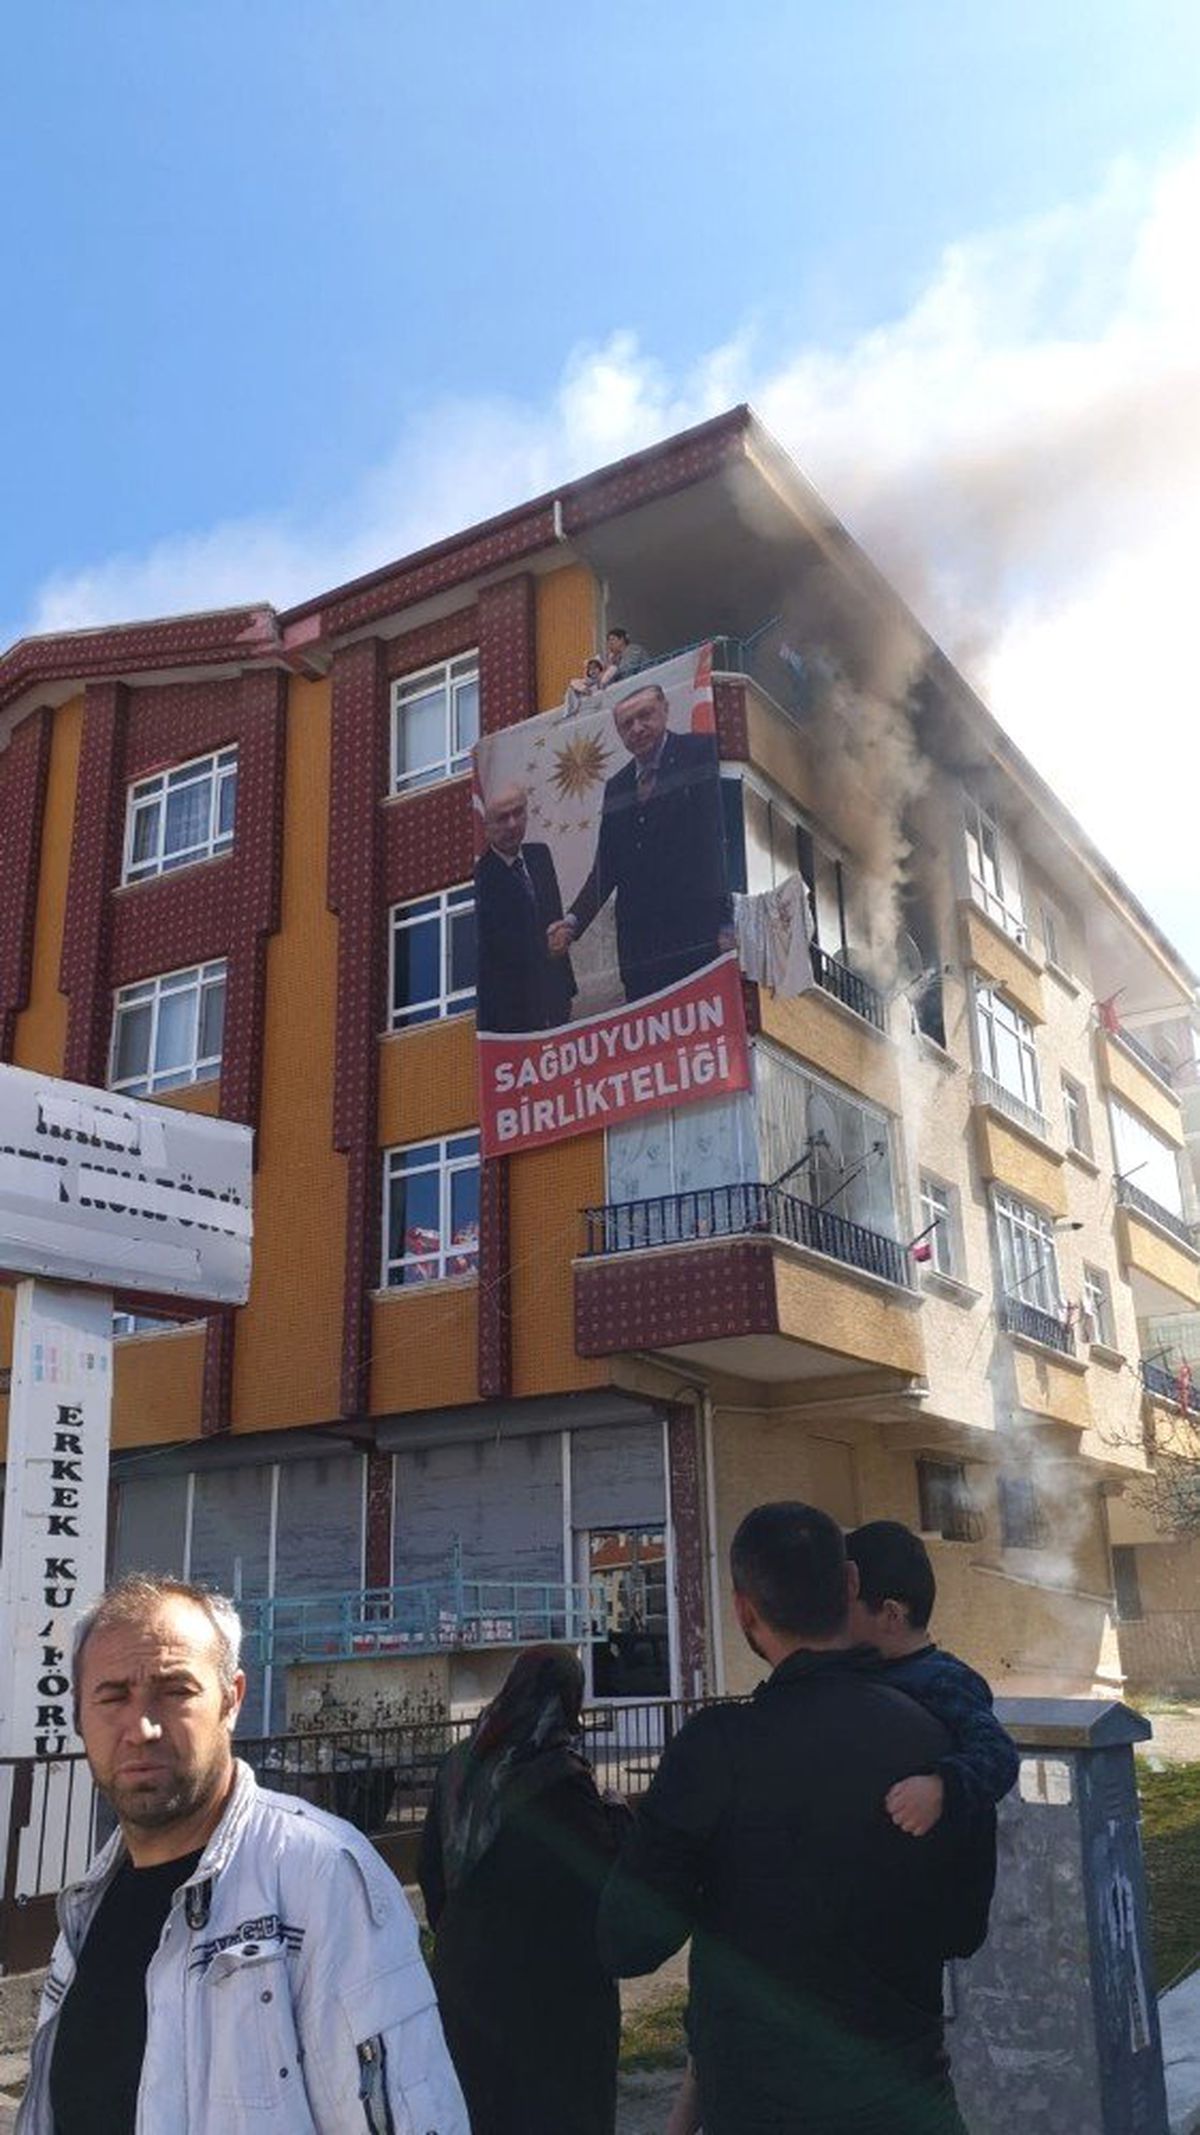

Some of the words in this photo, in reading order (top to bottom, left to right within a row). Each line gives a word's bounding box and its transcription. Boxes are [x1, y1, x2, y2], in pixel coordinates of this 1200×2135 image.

[494, 995, 725, 1093] SAĞDUYUNUN
[496, 1036, 730, 1141] BİRLİKTELİĞİ
[47, 1404, 84, 1537] ERKEK
[34, 1557, 77, 1757] KUFÖRÜ
